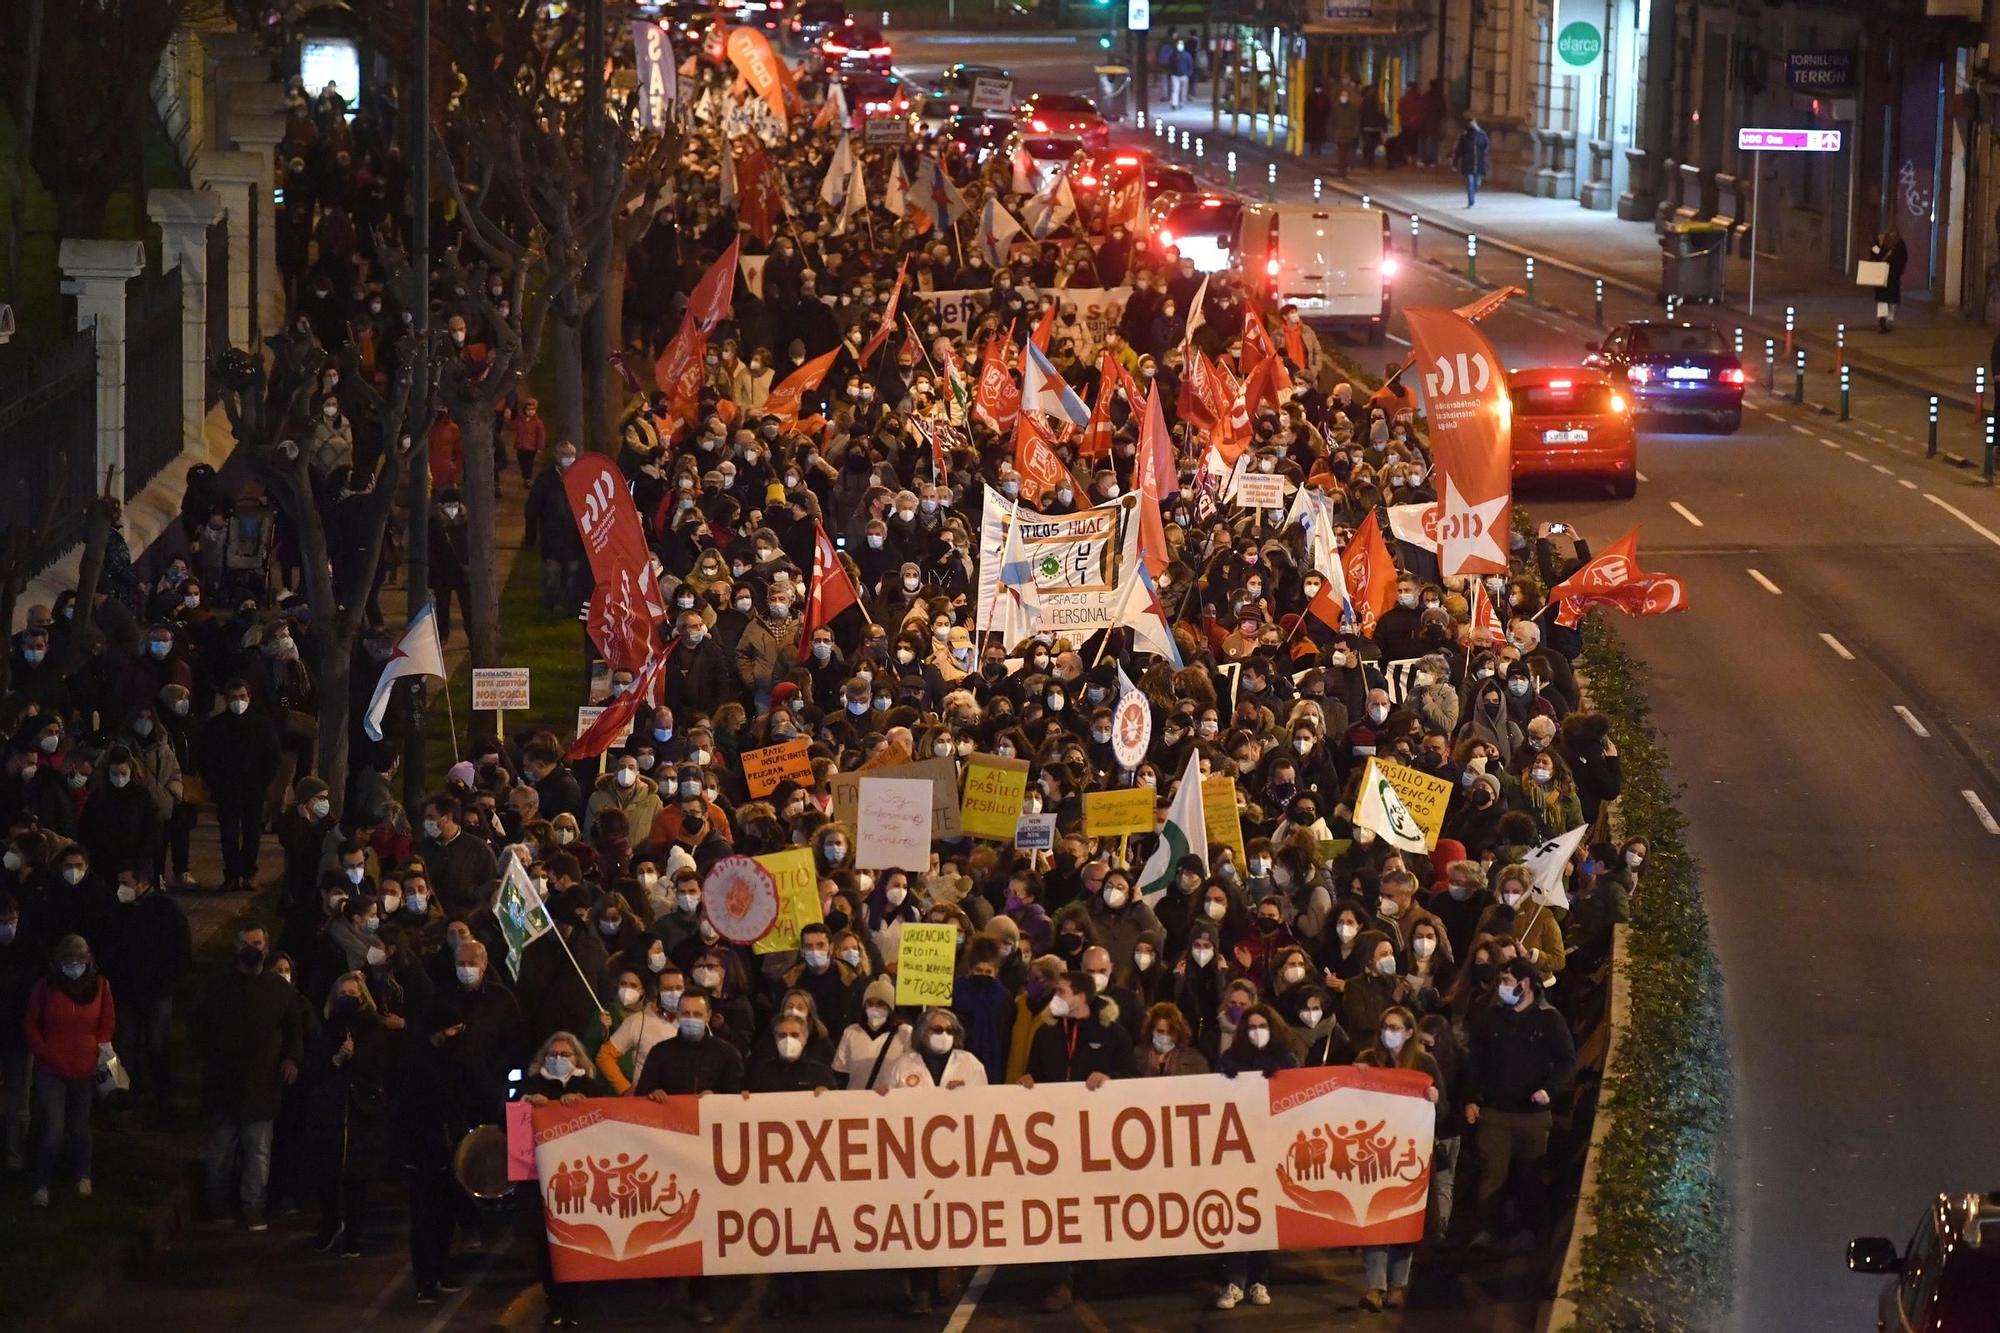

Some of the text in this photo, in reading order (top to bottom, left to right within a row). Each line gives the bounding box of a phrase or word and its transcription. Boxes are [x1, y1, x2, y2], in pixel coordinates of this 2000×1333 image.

[1020, 518, 1104, 538] ITICOS HUAC
[1052, 607, 1112, 625] PERSONAL
[743, 752, 758, 762] CON
[762, 777, 777, 787] LOS
[970, 779, 1020, 798] PASILLO
[1427, 781, 1446, 794] EN
[965, 798, 1016, 816] PESTILLO
[1271, 1076, 1339, 1114] COIDARTE
[534, 1108, 605, 1144] COIDARTE
[712, 1102, 1256, 1186] URXENCIAS LOITA
[717, 1187, 1262, 1258] POLA SAÚDE DE TOD@S
